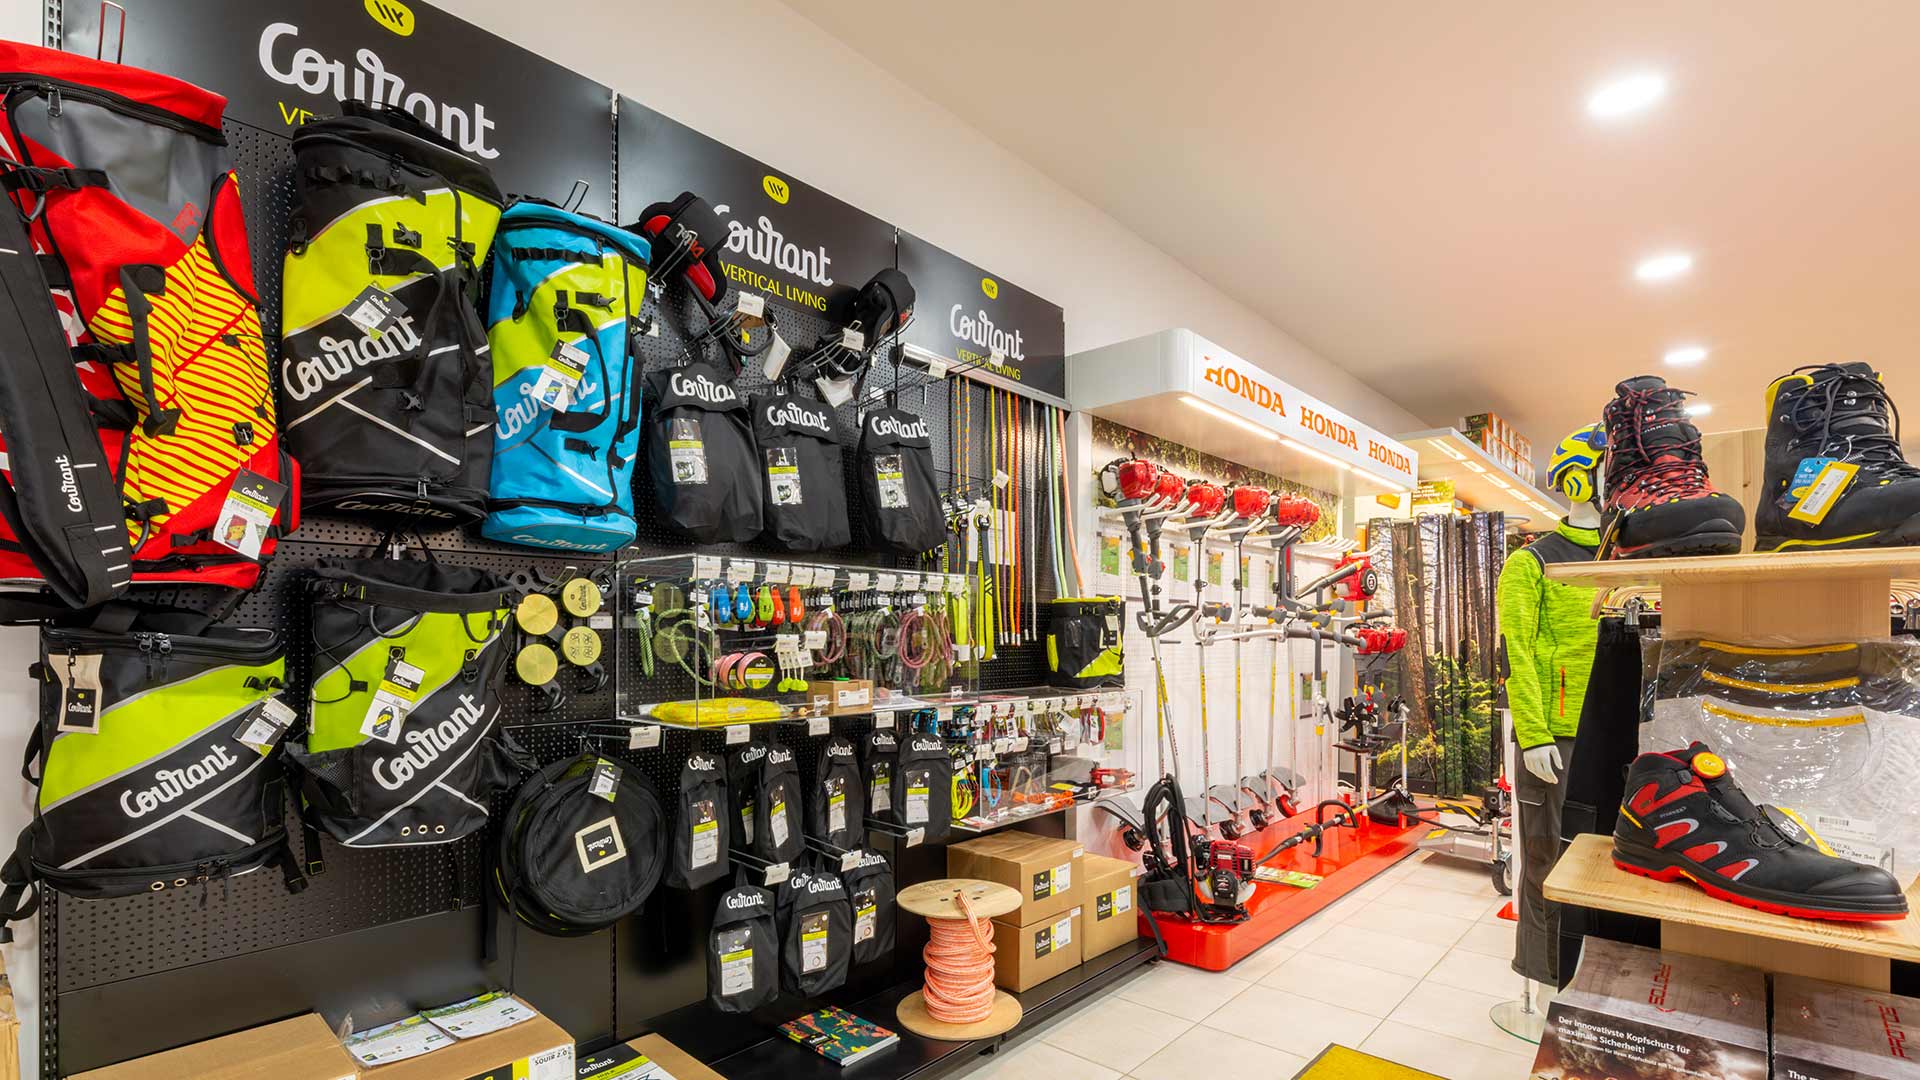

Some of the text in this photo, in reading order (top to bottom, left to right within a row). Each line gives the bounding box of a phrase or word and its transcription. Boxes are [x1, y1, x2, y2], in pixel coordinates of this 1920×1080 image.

[720, 260, 827, 312] VERTICAL LIVING
[950, 303, 1025, 361] Courant
[995, 363, 1021, 380] LIVING
[766, 402, 831, 432] Courant
[1300, 405, 1359, 451] HONDA
[1368, 439, 1412, 475] HONDA
[55, 455, 83, 513] Courant
[512, 534, 608, 551] Courant
[68, 702, 93, 714] Courant
[372, 693, 485, 791] Courant
[120, 744, 238, 819] Courant
[808, 875, 842, 894] Courant
[726, 892, 765, 910] Courant
[1558, 1015, 1573, 1026] Der
[1626, 1032, 1676, 1051] Kopfschutz
[1676, 1044, 1691, 1055] für
[1599, 1036, 1646, 1054] Sicherheit!
[578, 1057, 615, 1075] Courant
